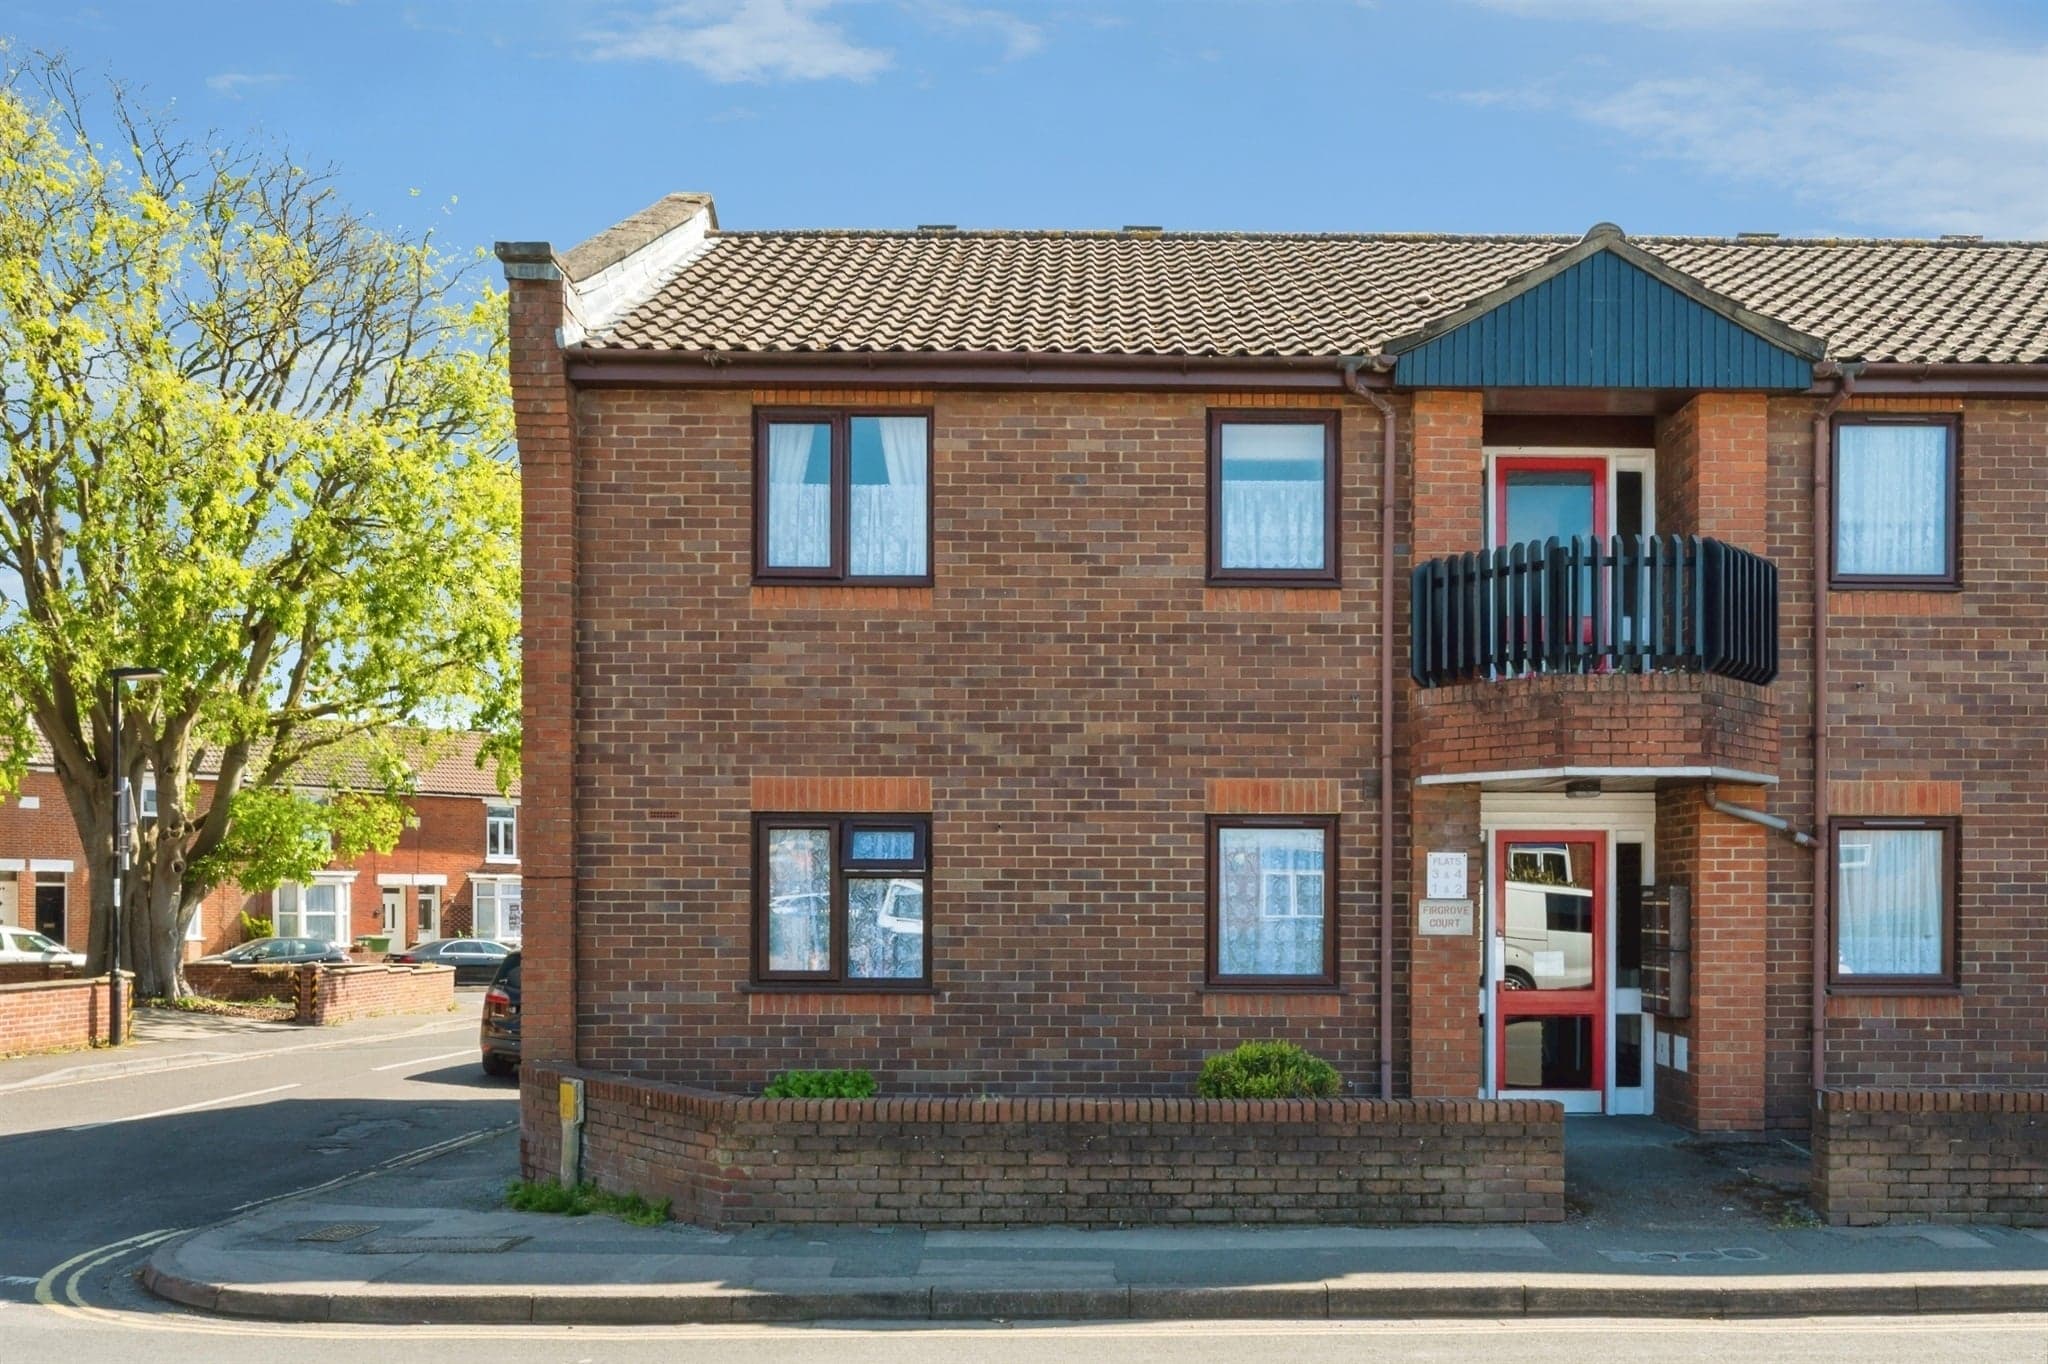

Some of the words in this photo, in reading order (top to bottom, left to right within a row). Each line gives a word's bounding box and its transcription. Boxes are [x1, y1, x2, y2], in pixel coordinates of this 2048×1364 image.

[1432, 857, 1462, 866] FLATS
[1454, 869, 1462, 879] 4
[1455, 883, 1462, 894] 2
[1422, 905, 1471, 915] FIRGROVE
[1429, 918, 1461, 928] COURT
